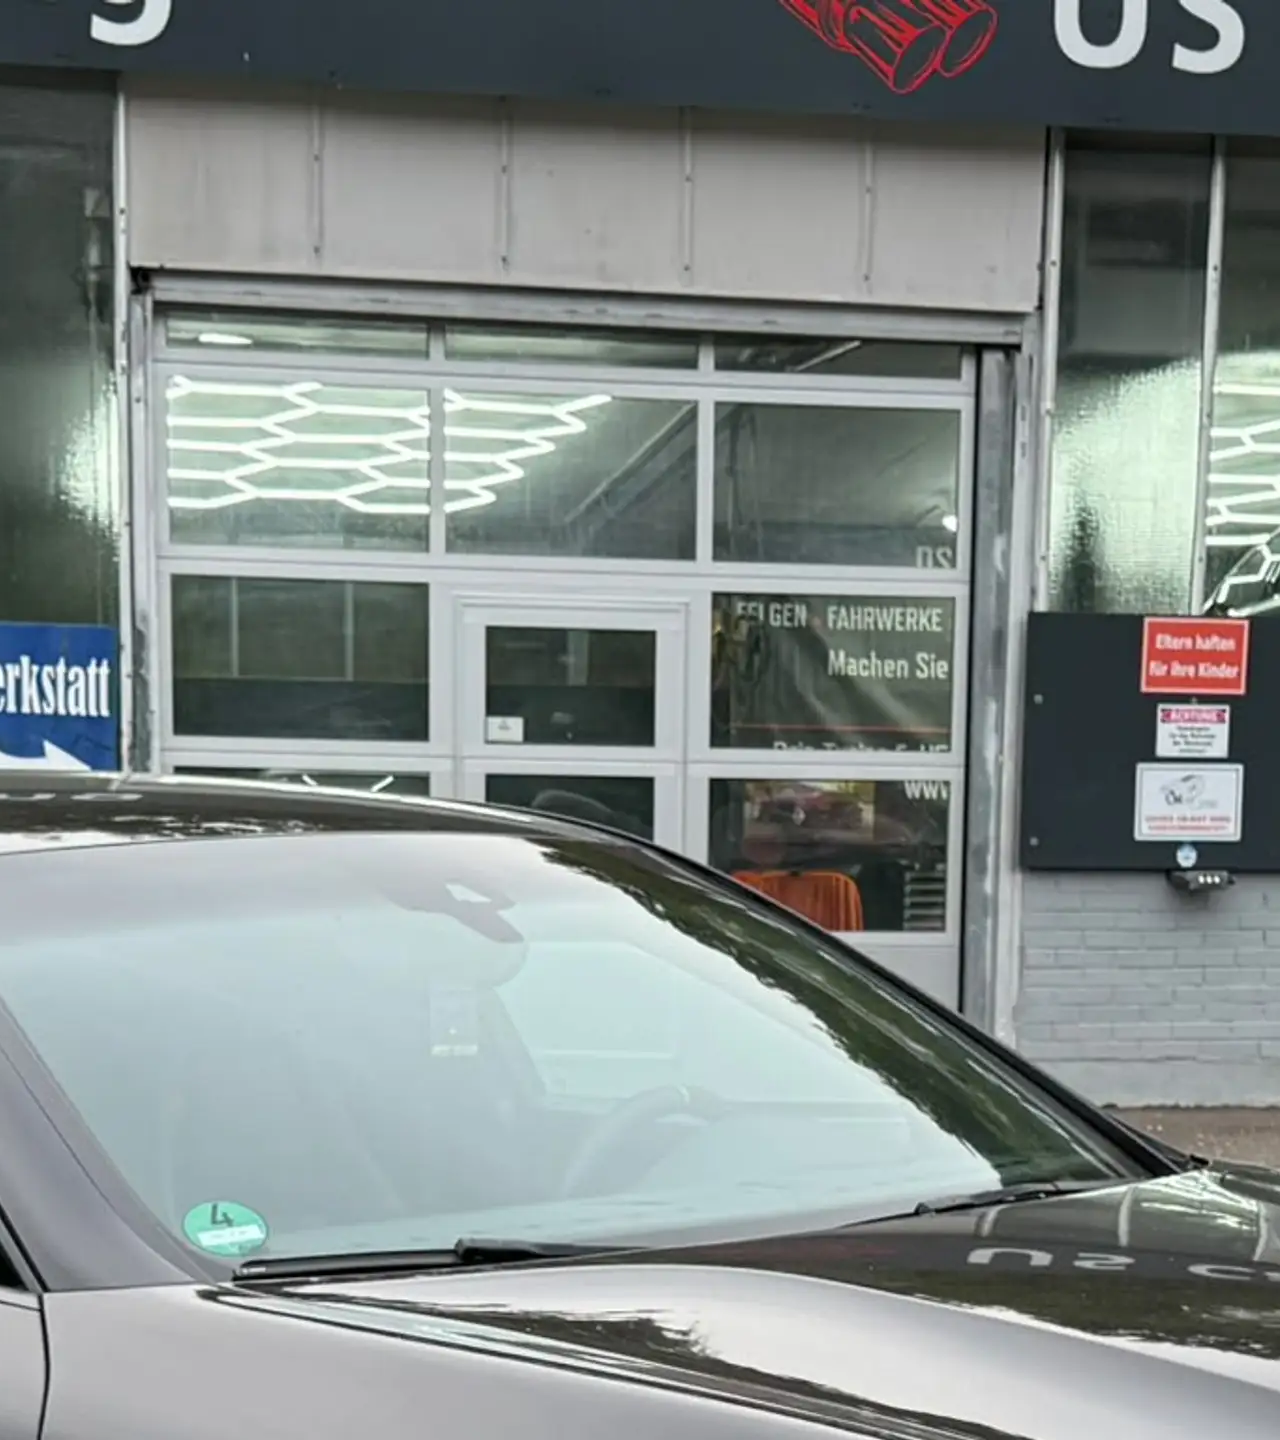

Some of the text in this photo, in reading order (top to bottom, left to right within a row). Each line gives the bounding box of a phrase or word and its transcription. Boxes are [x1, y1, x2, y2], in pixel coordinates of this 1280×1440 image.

[827, 604, 943, 632] FAHRWERKE
[827, 649, 949, 680] Machen Sie
[210, 1203, 234, 1227] 4
